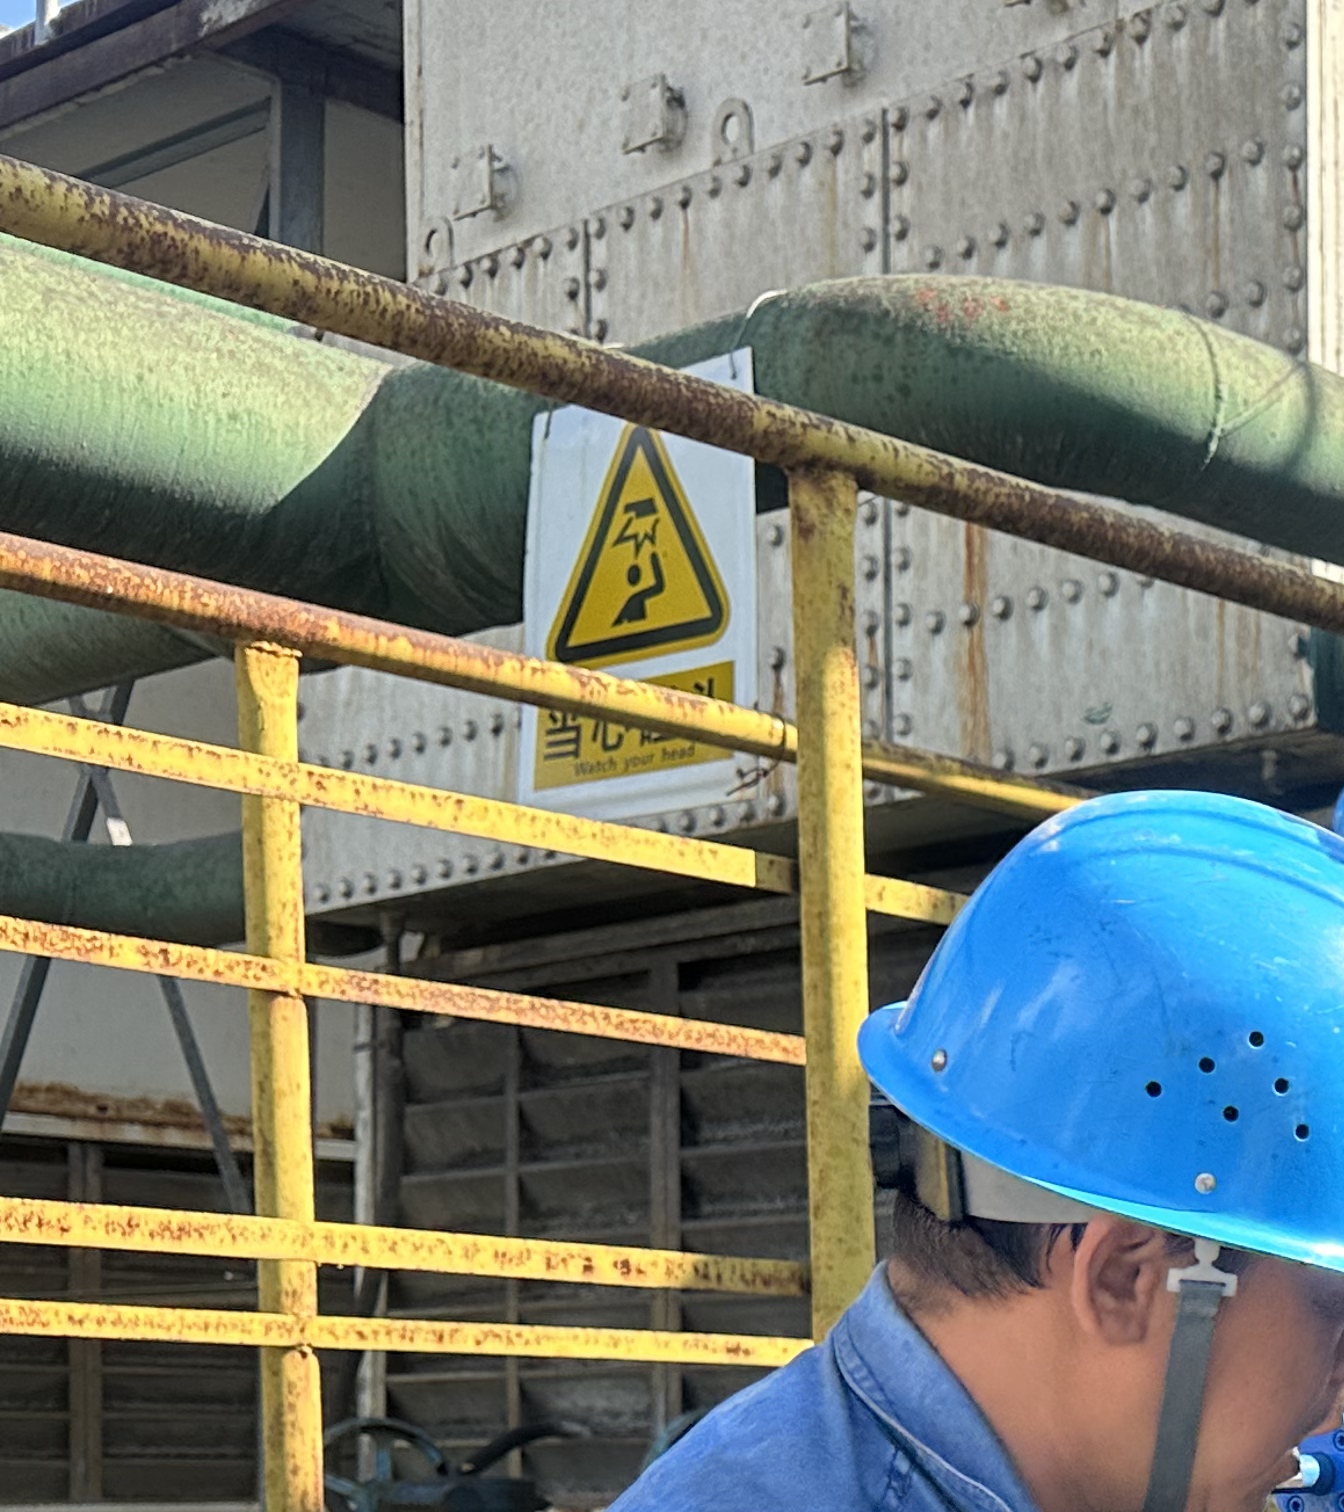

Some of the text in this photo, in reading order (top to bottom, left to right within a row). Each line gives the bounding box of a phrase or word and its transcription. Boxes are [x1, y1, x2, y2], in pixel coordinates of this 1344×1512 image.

[574, 744, 696, 777] Watch your head
